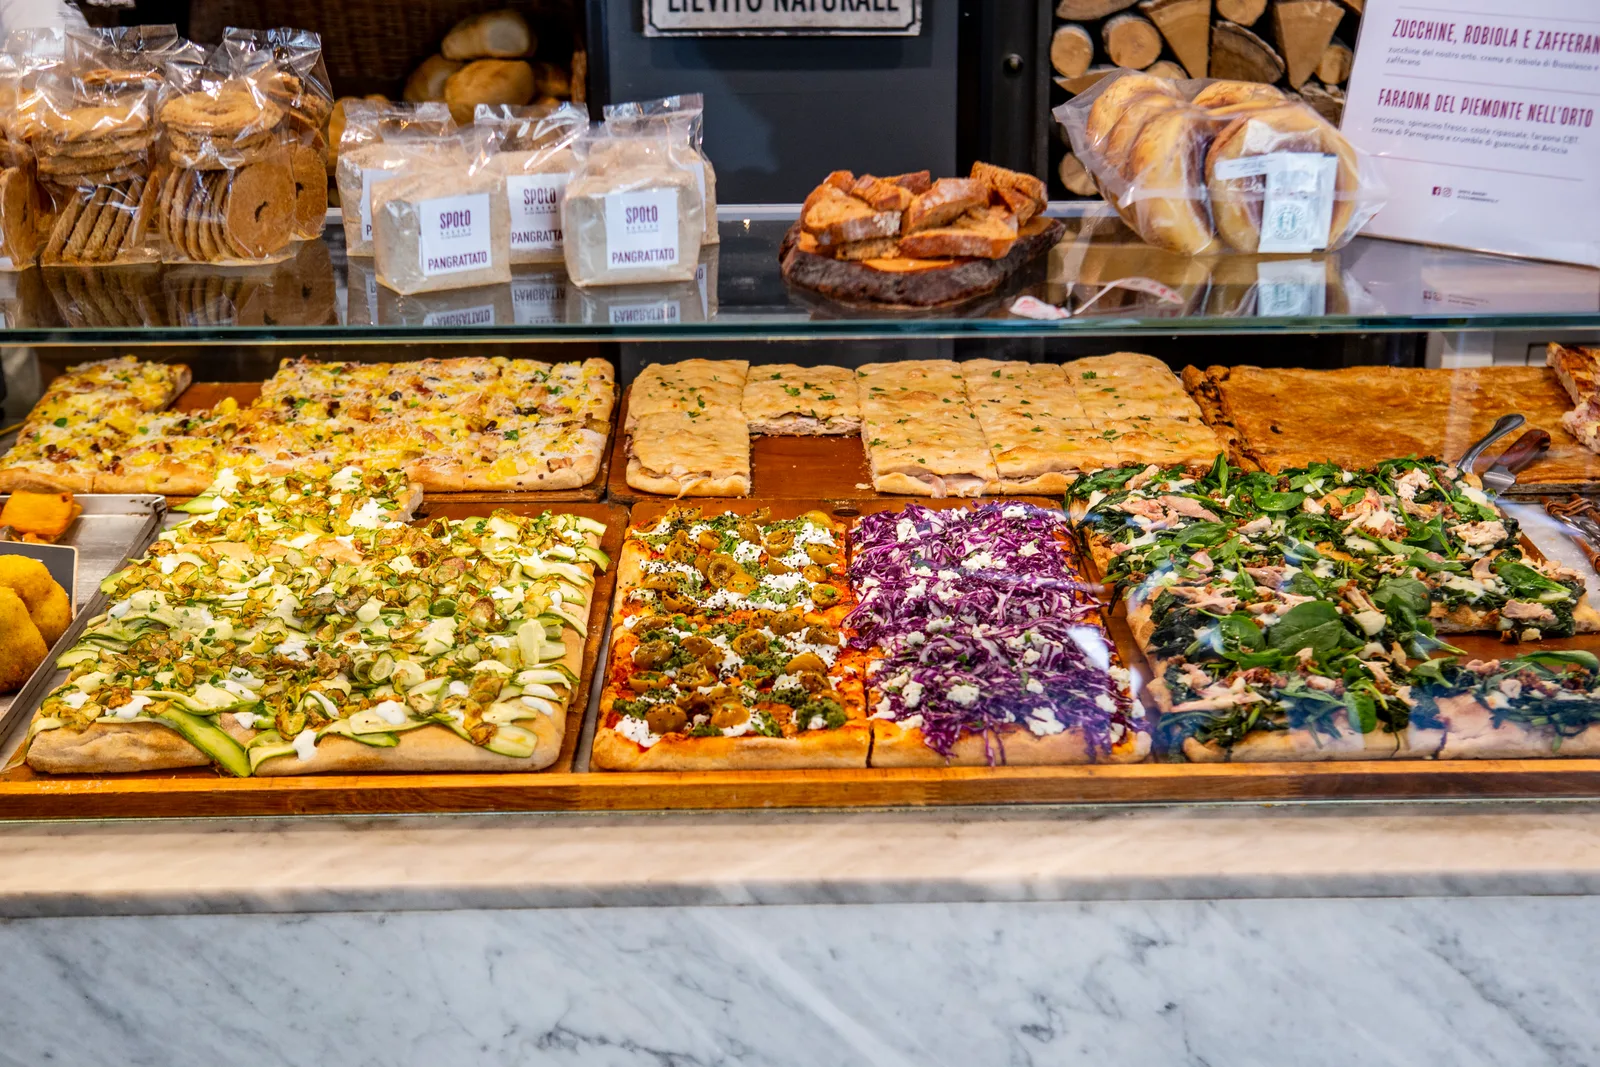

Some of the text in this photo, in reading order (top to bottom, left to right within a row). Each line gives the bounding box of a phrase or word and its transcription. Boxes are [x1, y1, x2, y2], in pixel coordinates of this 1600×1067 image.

[1392, 18, 1457, 45] ZUCCHINE,
[1463, 24, 1519, 47] ROBIOLA
[1522, 29, 1532, 48] E
[1377, 88, 1431, 110] FARAONA
[1434, 94, 1455, 114] DEL
[1460, 96, 1525, 120] PIEMONTE
[428, 251, 488, 270] PANGRATTATO
[612, 247, 675, 264] PANGRATTATO
